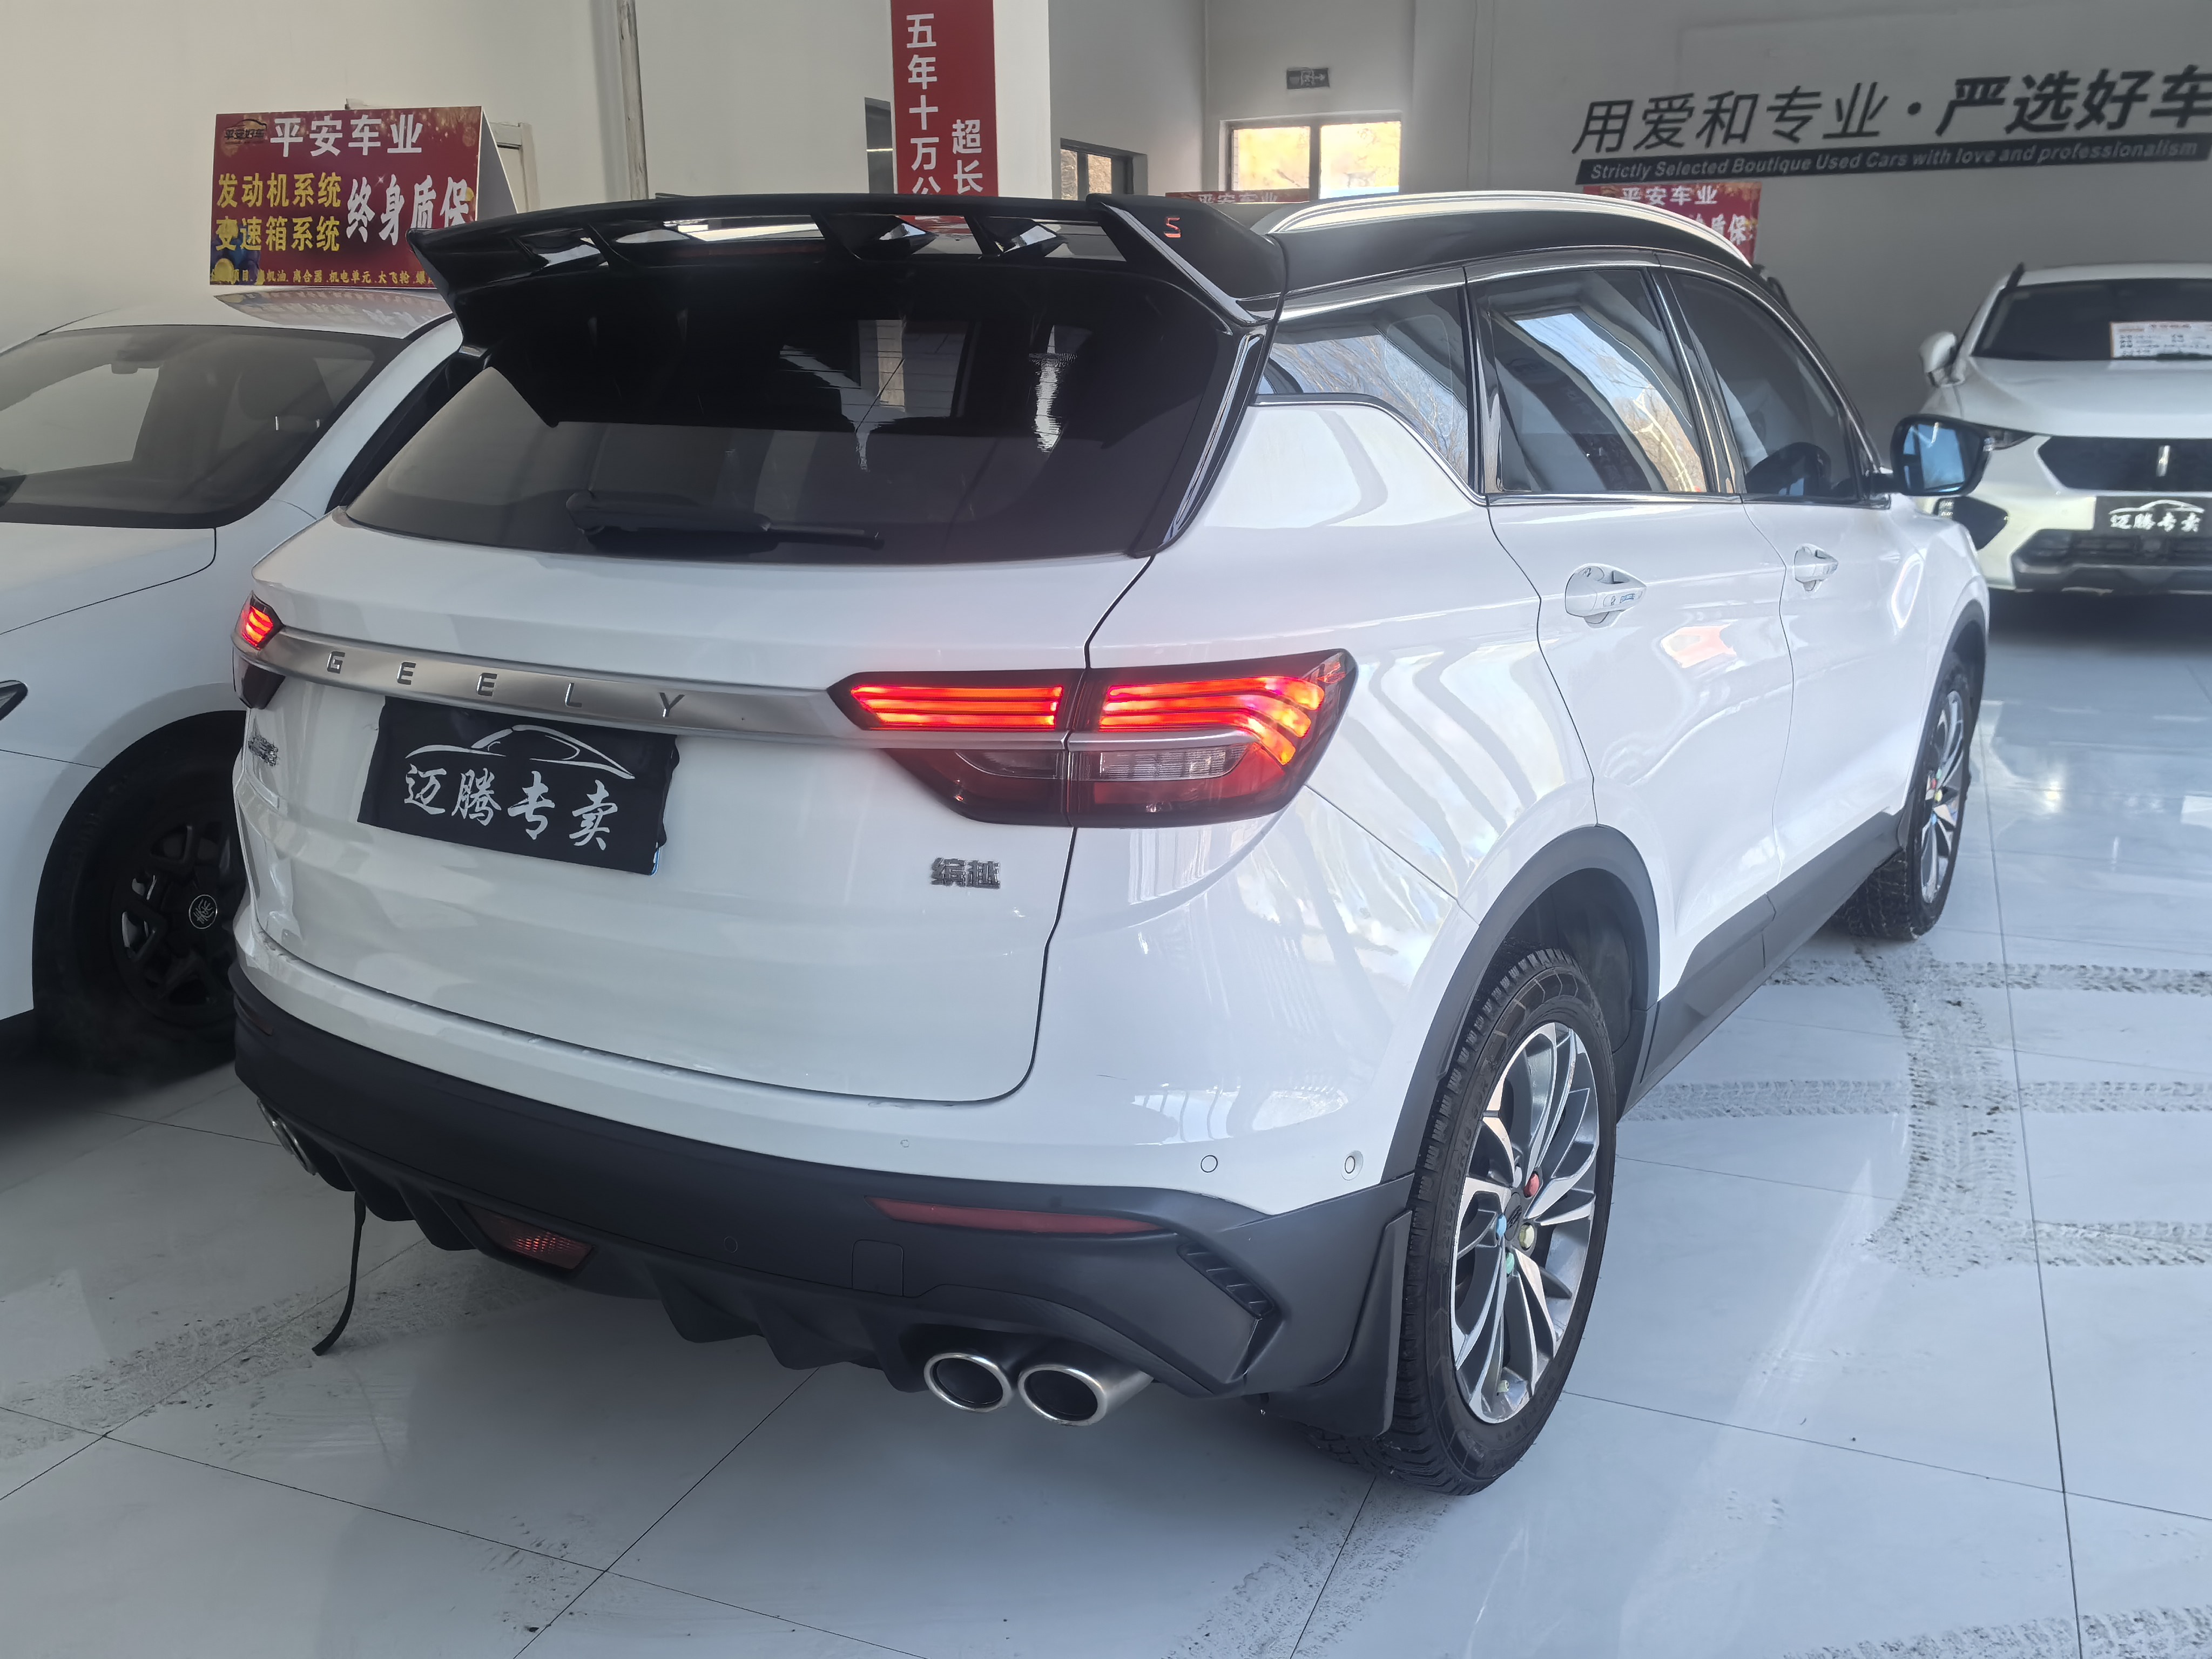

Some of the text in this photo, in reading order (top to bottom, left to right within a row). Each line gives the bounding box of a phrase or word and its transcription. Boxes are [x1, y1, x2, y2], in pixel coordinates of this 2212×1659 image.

[271, 114, 423, 157] 平安车业
[952, 119, 983, 194] 超长
[1591, 139, 2197, 180] Strictly Selected Boutique Used Cars with love and professionalism
[217, 172, 341, 207] 发动机系统
[1621, 185, 1717, 206] 平安车业
[216, 216, 340, 252] 变速箱系统
[1163, 217, 1181, 238] S
[326, 650, 684, 717] GEELY
[404, 764, 618, 851] 迈腾专卖
[931, 857, 1001, 889] 缤越
